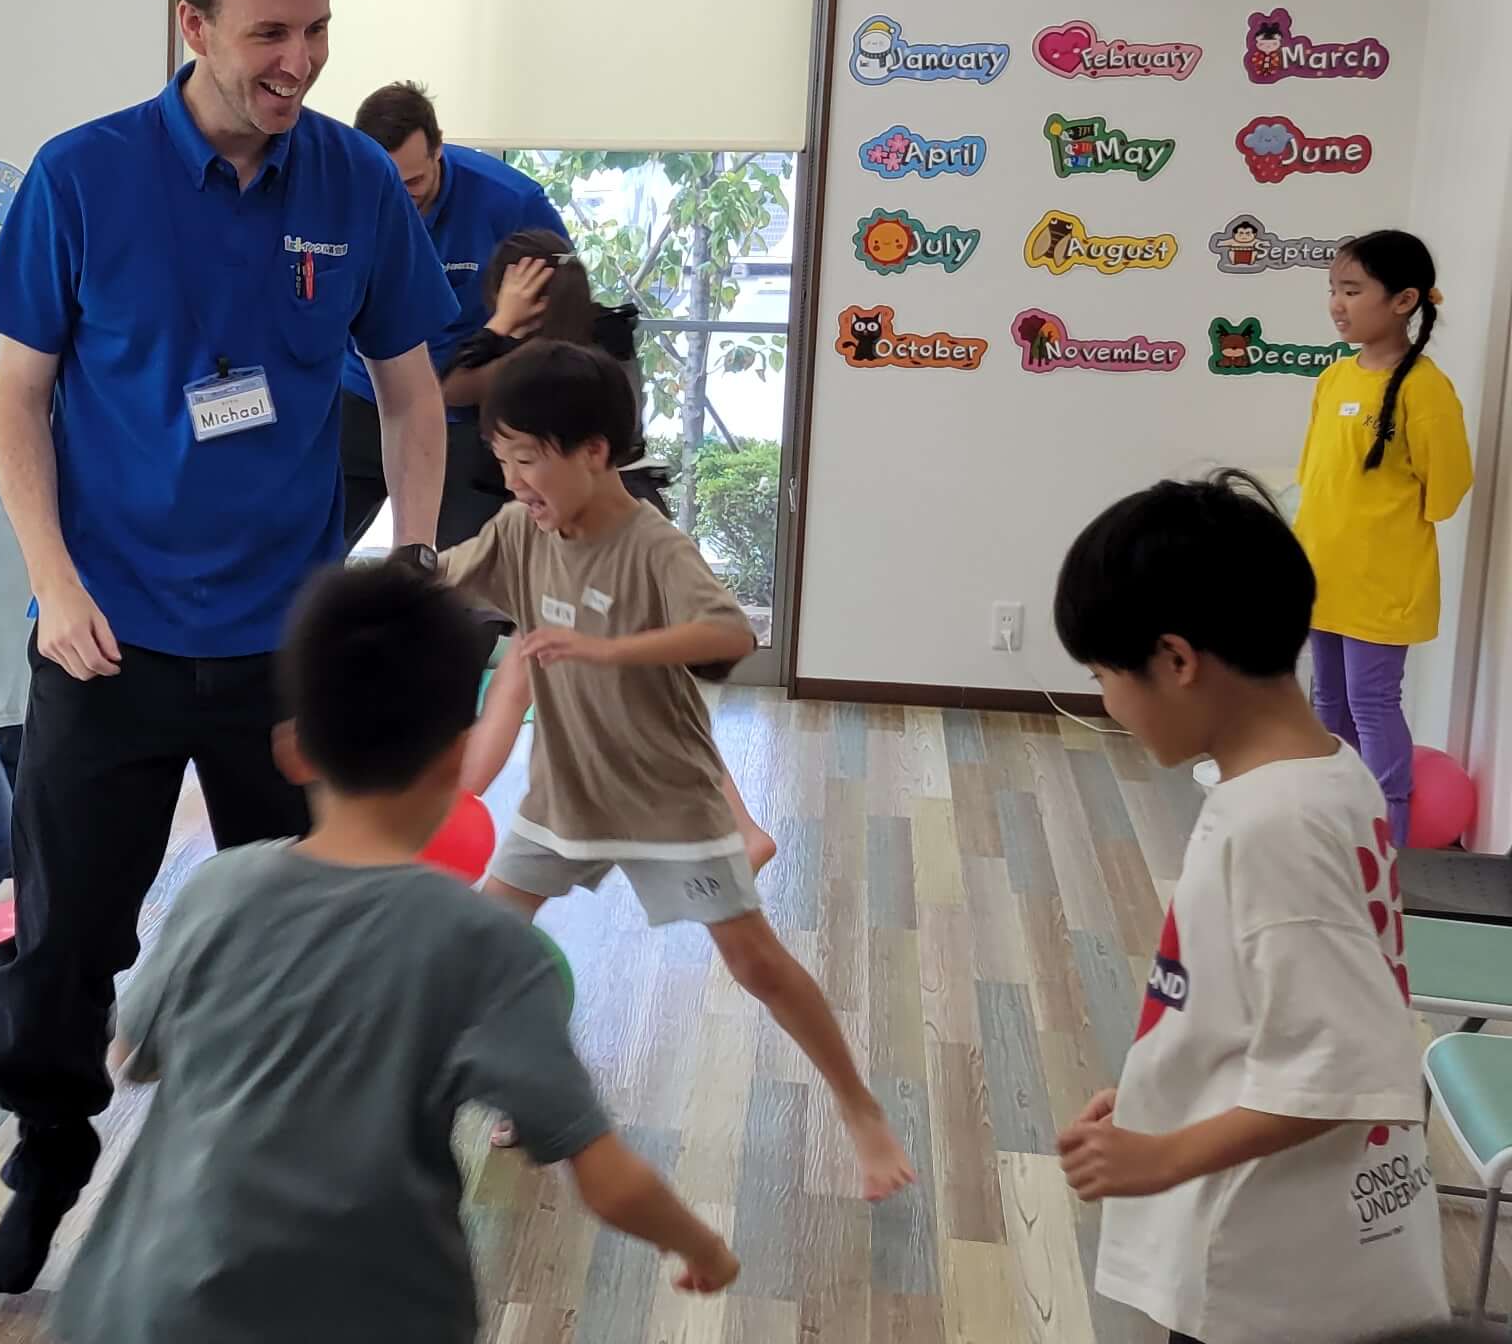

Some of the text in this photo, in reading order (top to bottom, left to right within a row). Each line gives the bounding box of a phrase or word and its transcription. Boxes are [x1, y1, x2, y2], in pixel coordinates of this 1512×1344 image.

[887, 47, 1004, 76] January
[1081, 47, 1194, 73] February
[1282, 44, 1380, 69] March
[904, 142, 978, 168] April
[1095, 139, 1165, 171] May
[1282, 138, 1363, 165] June
[908, 231, 973, 262] July
[1068, 238, 1169, 266] August
[1255, 240, 1338, 262] Septem
[874, 339, 978, 361] October
[1045, 341, 1178, 362] November
[1247, 345, 1342, 366] Decem
[200, 399, 265, 429] Michael
